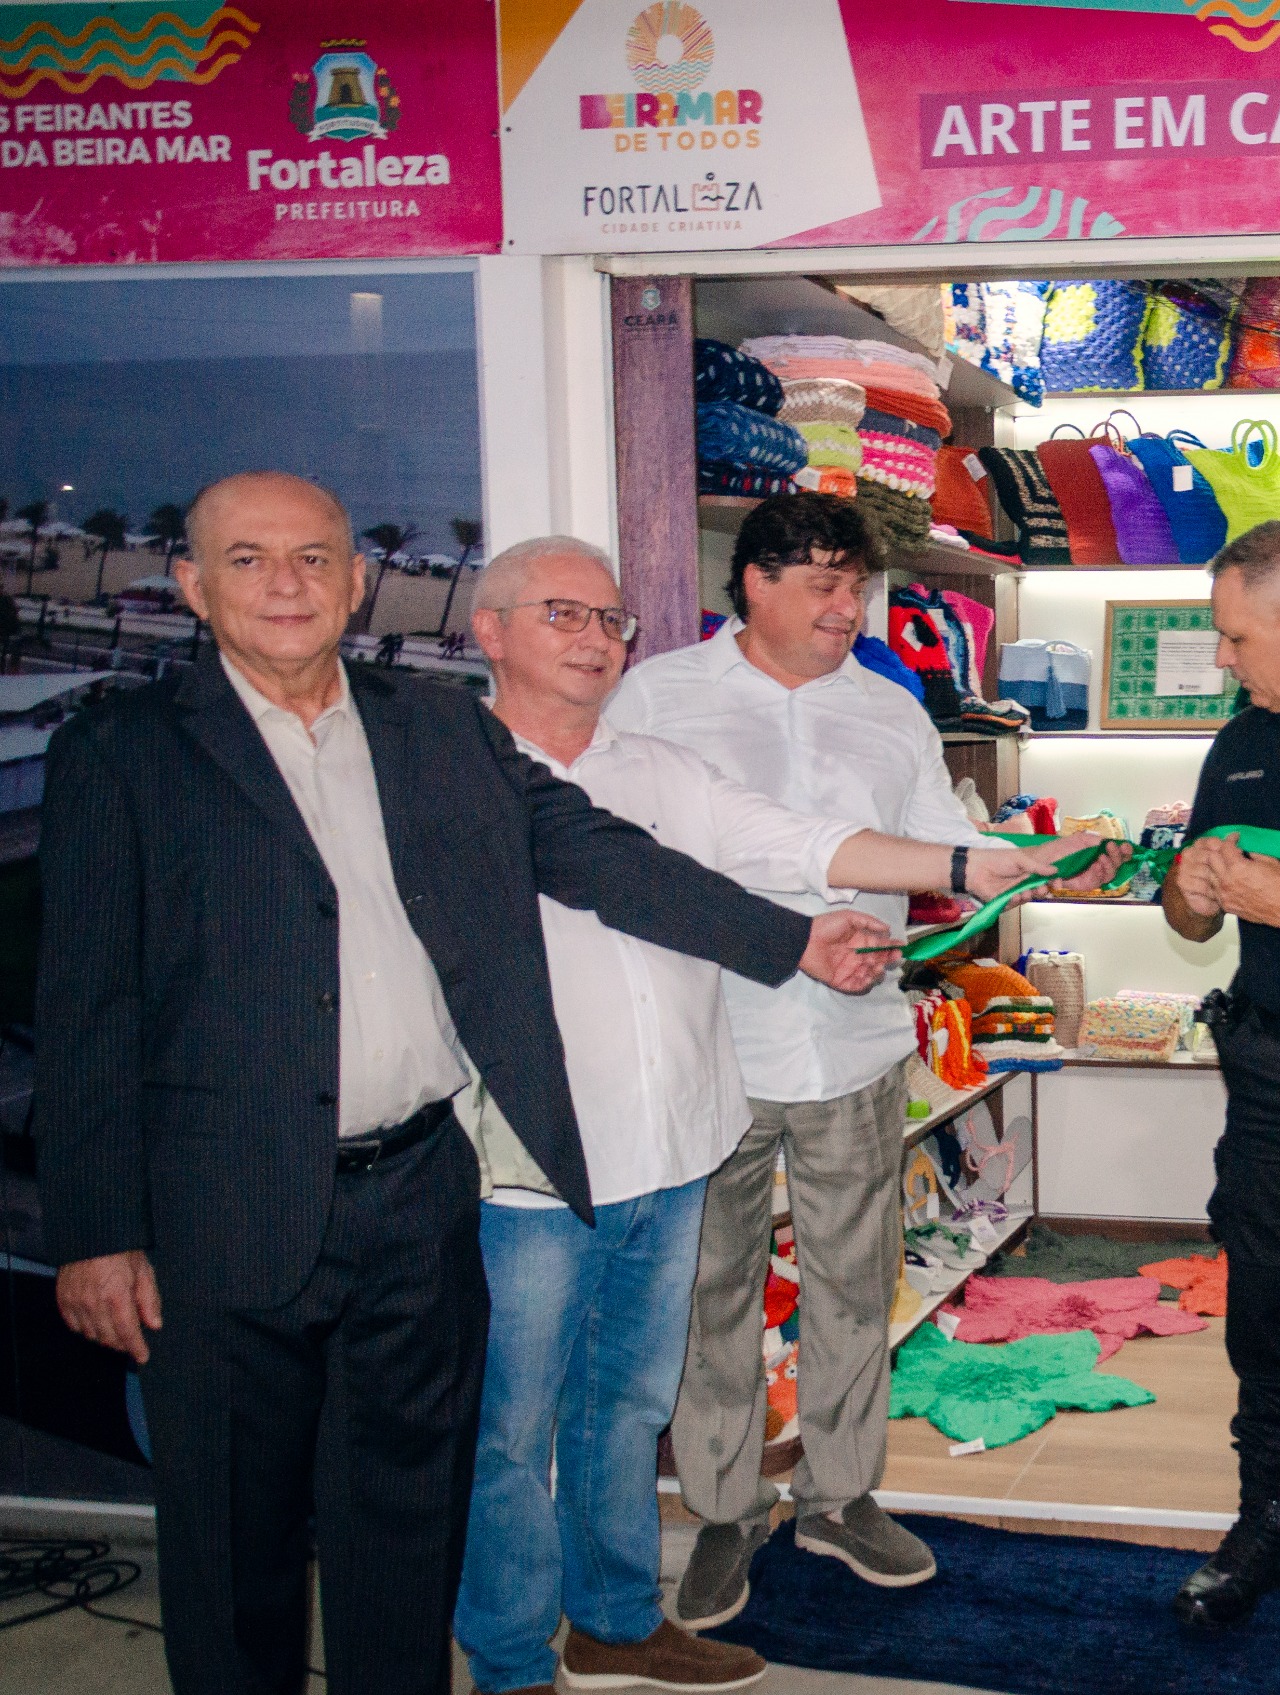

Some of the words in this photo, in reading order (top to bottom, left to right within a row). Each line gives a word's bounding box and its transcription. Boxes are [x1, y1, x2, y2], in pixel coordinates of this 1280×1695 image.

[15, 101, 193, 133] FEIRANTES
[932, 100, 1092, 157] ARTE
[1114, 95, 1206, 150] EM
[1, 139, 48, 168] DA
[53, 137, 152, 167] BEIRA
[157, 134, 232, 163] MAR
[614, 132, 648, 153] DE
[656, 129, 761, 151] TODOS
[247, 145, 450, 191] Fortaleza
[275, 199, 420, 221] PREFEITURA
[583, 172, 763, 216] FORTALZA
[601, 221, 660, 234] CIDADE
[668, 220, 743, 233] CRIATIVA
